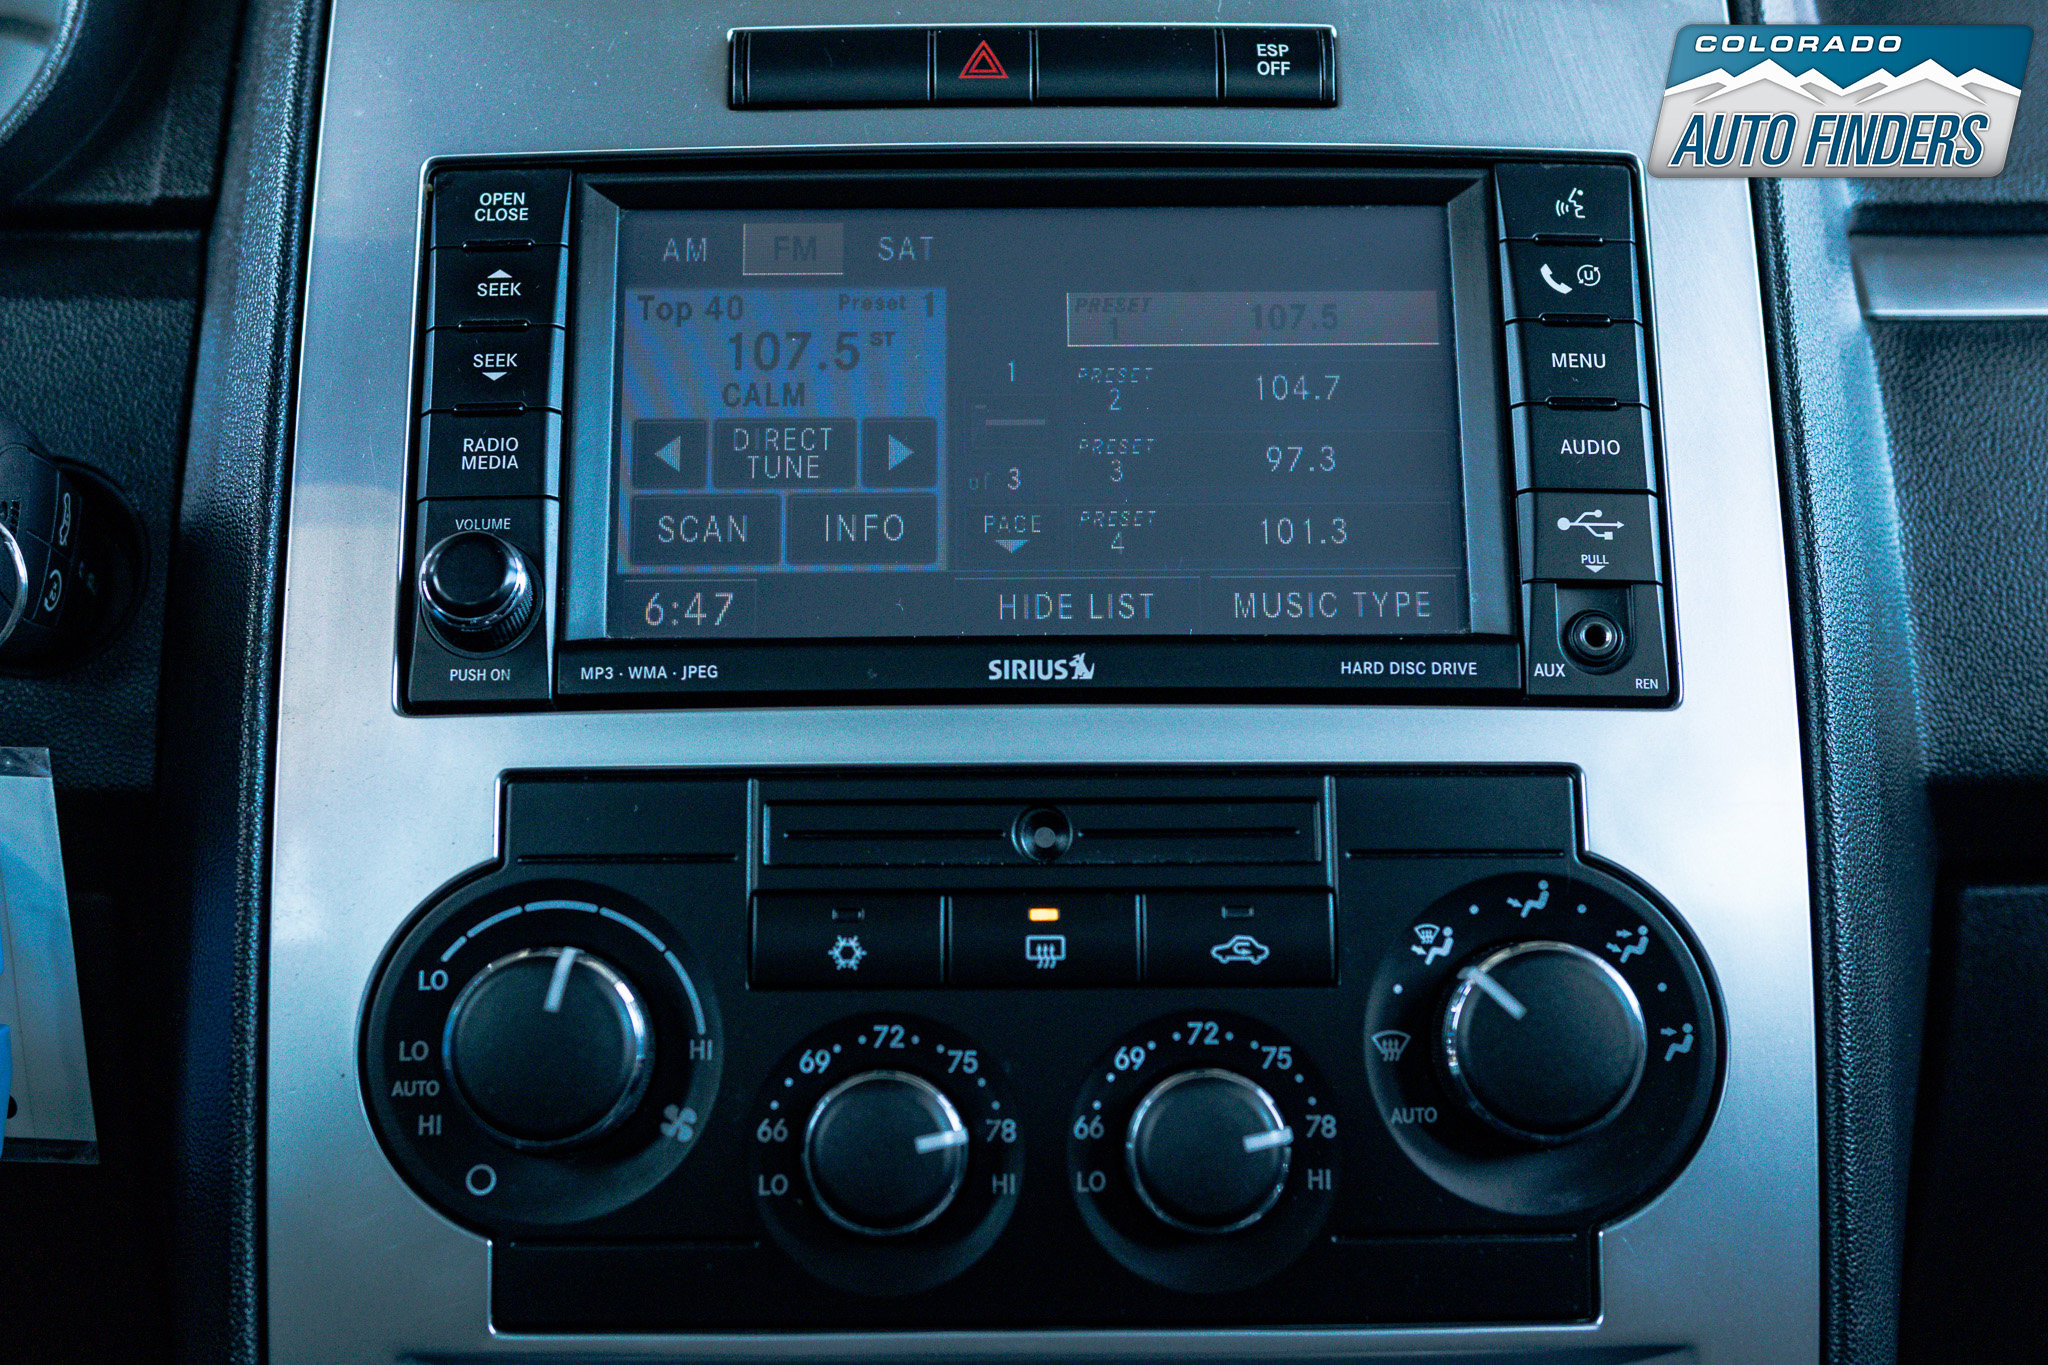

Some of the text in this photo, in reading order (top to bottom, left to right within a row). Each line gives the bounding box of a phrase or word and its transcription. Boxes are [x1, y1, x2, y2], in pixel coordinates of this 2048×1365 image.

[1257, 44, 1289, 58] ESP
[1257, 61, 1291, 76] OFF
[479, 192, 525, 206] OPEN
[475, 207, 529, 222] CLOSE
[663, 238, 708, 262] AM
[773, 238, 817, 262] FM
[878, 236, 934, 261] SAT
[477, 283, 522, 297] SEEK
[637, 294, 744, 327] Top 40
[838, 293, 935, 317] Preset 1
[1074, 297, 1153, 314] PRESET
[1109, 318, 1118, 339] 1
[1250, 302, 1339, 332] 107.5
[473, 354, 518, 368] SEEK
[729, 331, 896, 371] 107.5 ST
[1551, 352, 1607, 368] MENU
[1007, 360, 1015, 382] 1
[1078, 367, 1154, 383] PRESET
[721, 382, 806, 408] CALM
[1110, 387, 1122, 411] 2
[1256, 374, 1341, 401] 104.7
[463, 437, 519, 453] RADIO
[733, 427, 832, 451] DIRECT
[1079, 438, 1155, 454] PRESET
[1560, 439, 1621, 456] AUDIO
[461, 454, 519, 470] MEDIA
[748, 456, 819, 480] TUNE
[1110, 458, 1124, 482] 3
[1265, 445, 1337, 472] 97.3
[1007, 466, 1022, 491] 3
[455, 517, 511, 531] VOLUME
[658, 515, 748, 544] SCAN
[825, 513, 904, 542] INFO
[1080, 510, 1157, 527] PRESET
[1110, 531, 1125, 554] 4
[1260, 517, 1349, 546] 101.3
[1580, 554, 1610, 565] PULL
[644, 592, 734, 627] 6:47
[999, 592, 1155, 620] HIDE LIST
[1233, 591, 1432, 619] MUSIC TYPE
[449, 668, 512, 682] PUSH ON
[580, 665, 719, 680] MP3 WMA JPEG
[988, 659, 1069, 681] SIRIUS
[1340, 660, 1478, 677] HARD DISC DRIVE
[1533, 663, 1566, 677] AUX
[1635, 678, 1659, 690] REN
[417, 969, 449, 991] LO
[873, 1024, 905, 1049] 72
[1186, 1021, 1220, 1046] 72
[398, 1040, 430, 1062] LO
[689, 1038, 713, 1061] HI
[1113, 1045, 1146, 1071] 69
[1261, 1046, 1293, 1070] 75
[799, 1049, 832, 1075] 69
[947, 1049, 979, 1074] 75
[391, 1080, 440, 1097] AUTO
[417, 1114, 443, 1136] HI
[1073, 1114, 1105, 1140] 66
[1305, 1114, 1338, 1140] 78
[1390, 1107, 1438, 1125] AUTO
[756, 1118, 789, 1143] 66
[985, 1118, 1018, 1143] 78
[757, 1174, 789, 1197] LO
[991, 1173, 1017, 1196] HI
[1076, 1170, 1107, 1194] LO
[1307, 1168, 1332, 1191] HI
